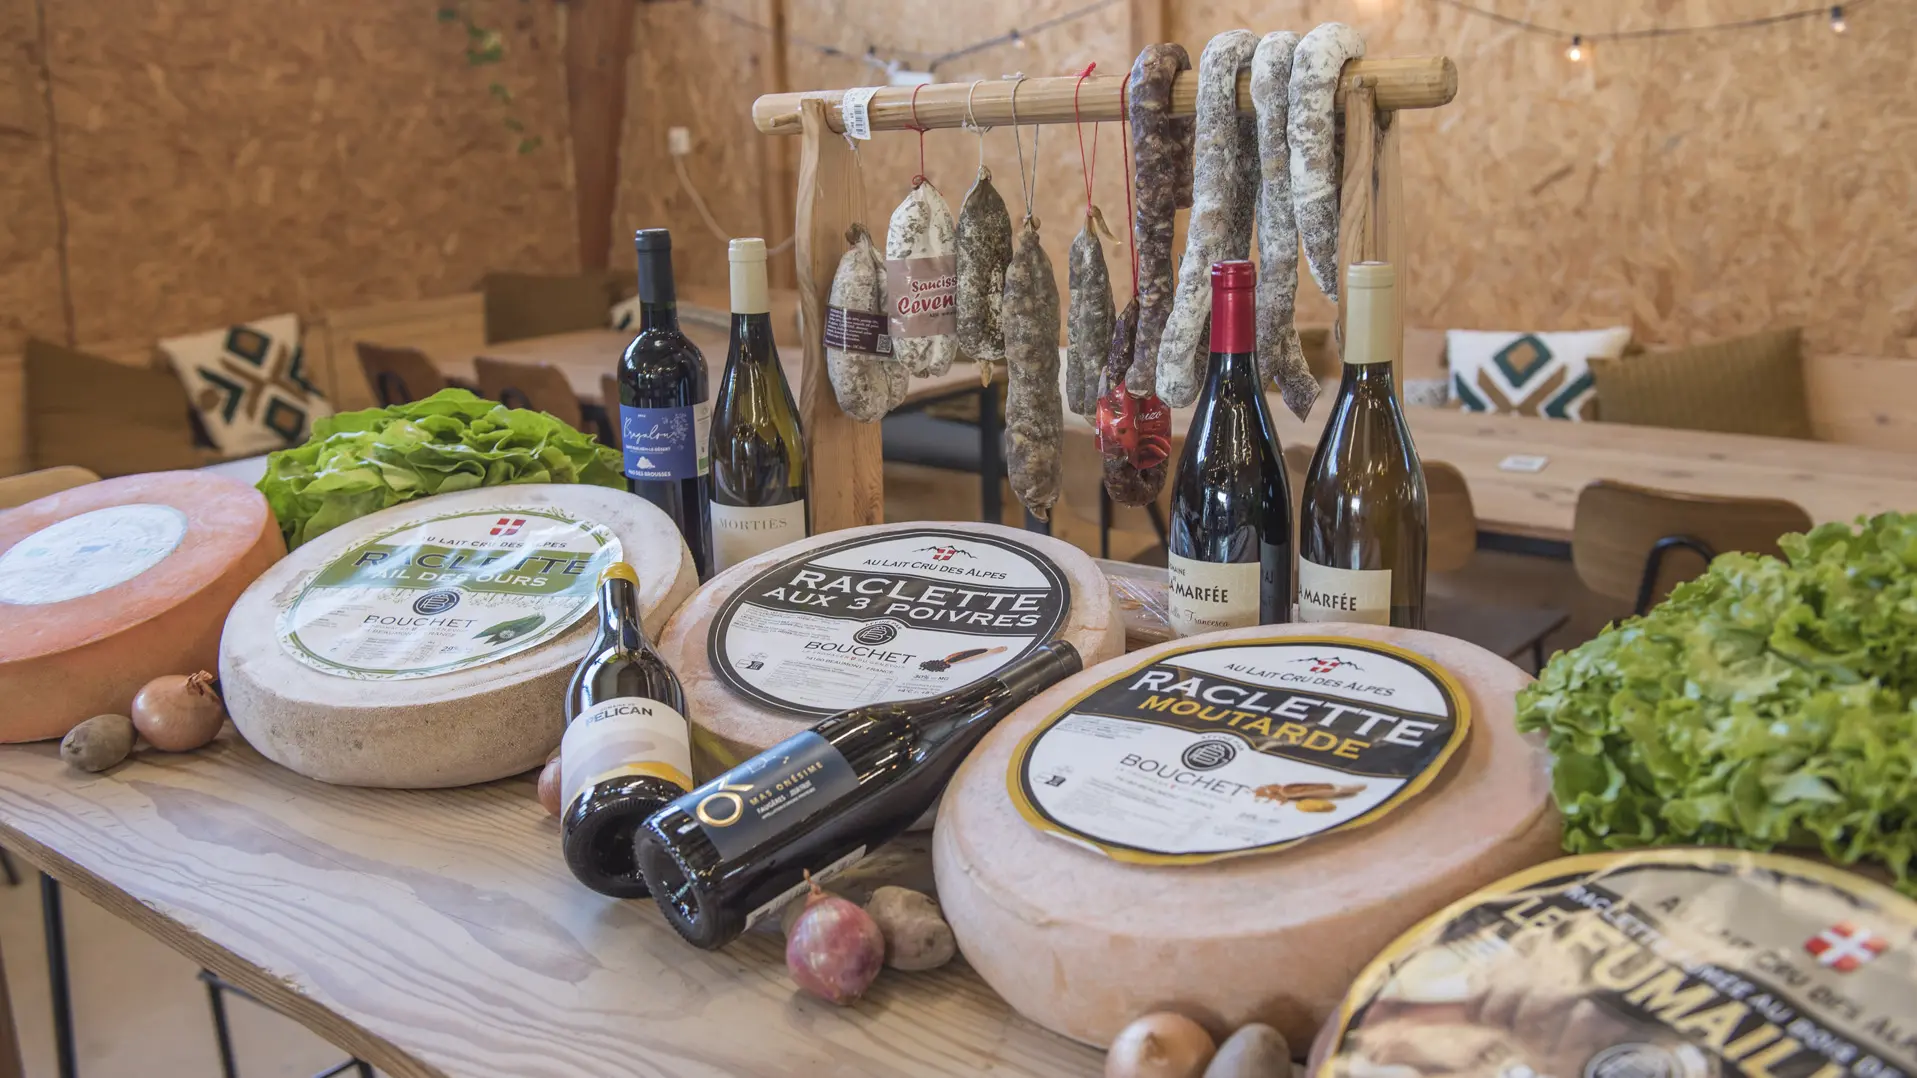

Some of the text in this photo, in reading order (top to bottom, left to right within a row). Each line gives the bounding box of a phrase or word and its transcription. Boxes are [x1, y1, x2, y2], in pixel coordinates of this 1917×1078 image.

[475, 571, 550, 588] OURS
[862, 558, 881, 567] AU
[911, 560, 938, 571] CRU
[938, 565, 965, 576] DES
[965, 567, 1008, 581] ALPES
[786, 568, 1050, 614] RACLETTE
[1175, 584, 1230, 604] MARFÉE
[1303, 586, 1357, 612] MARFÉE
[761, 586, 1043, 629] AUX 3 POIVRES
[363, 614, 479, 629] BOUCHET
[803, 640, 917, 665] BOUCHET
[1224, 663, 1247, 673] AU
[1280, 671, 1313, 684] CRU
[1313, 676, 1344, 689] DES
[1344, 679, 1395, 698] ALPES
[1127, 668, 1440, 749] RACLETTE
[1137, 694, 1375, 761] MOUTARDE
[1119, 752, 1251, 797] BOUCHET
[749, 788, 773, 806] MAS
